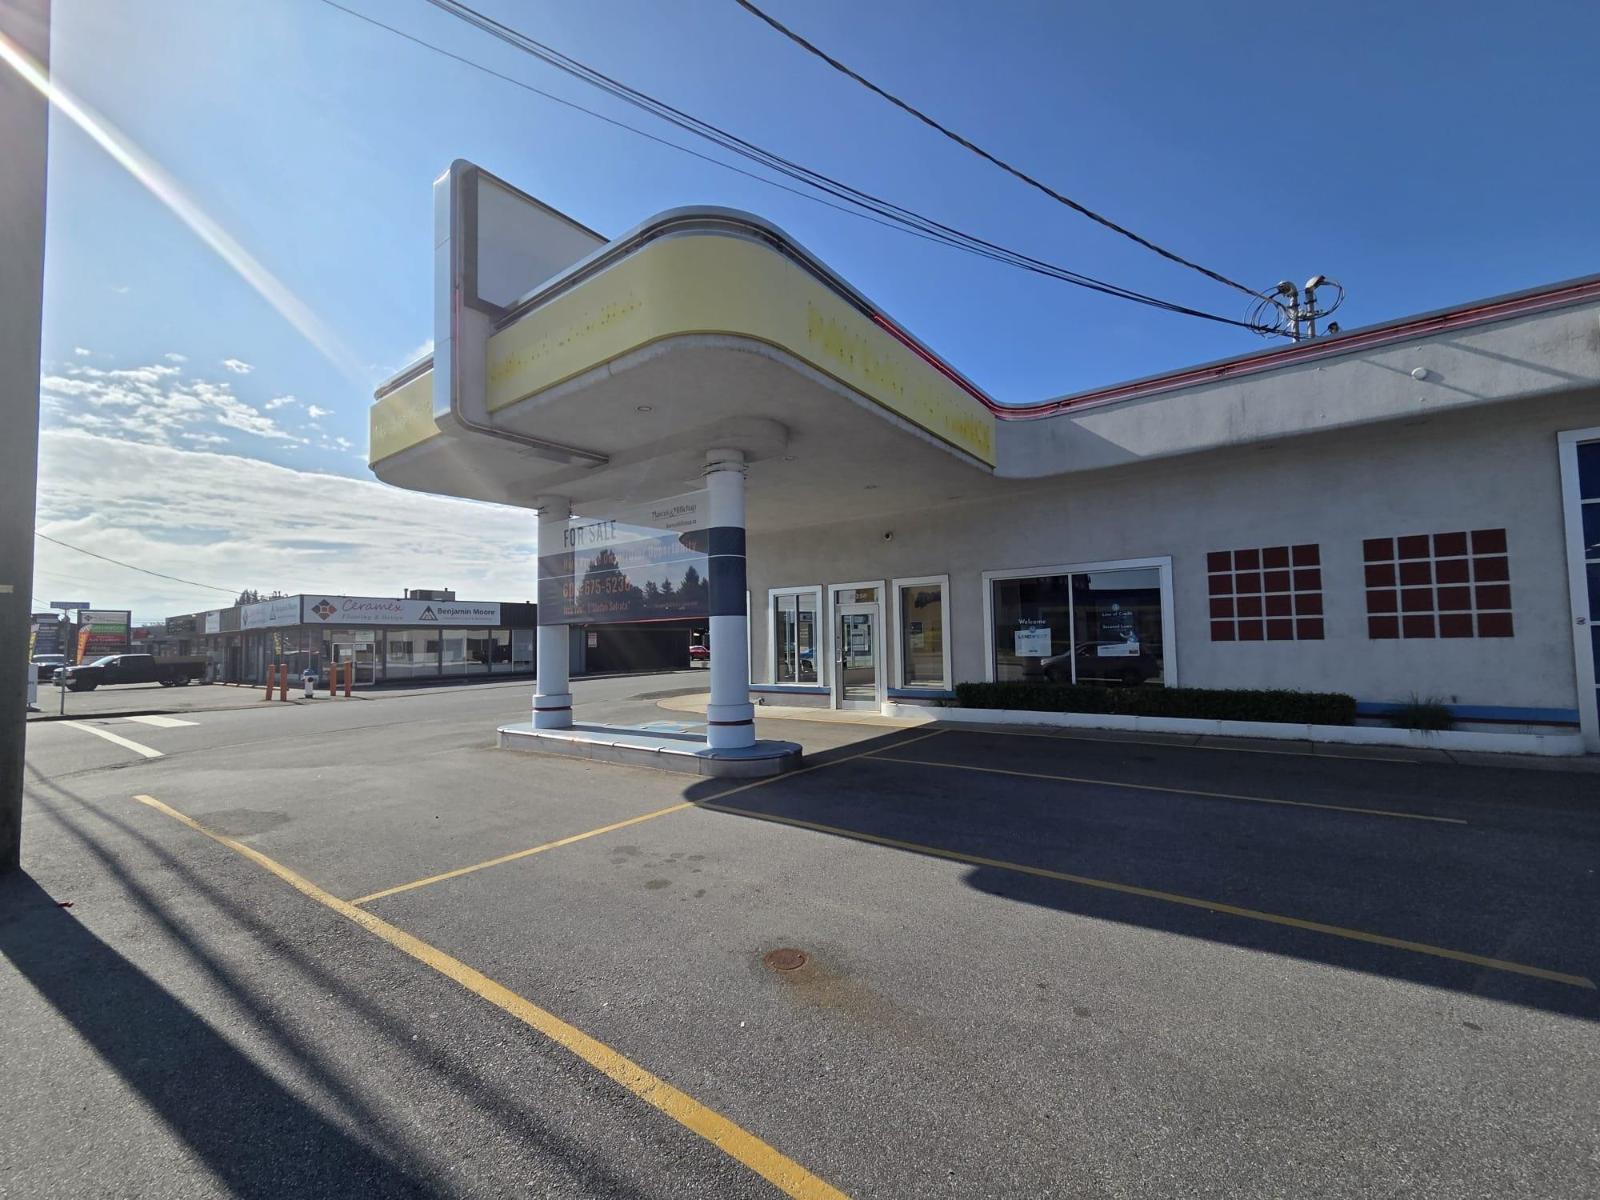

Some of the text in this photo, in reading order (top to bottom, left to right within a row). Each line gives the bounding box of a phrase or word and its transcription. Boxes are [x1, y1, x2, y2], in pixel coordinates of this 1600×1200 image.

[563, 519, 616, 548] FOR SALE
[437, 607, 472, 616] Benjamin
[472, 608, 496, 616] Moore
